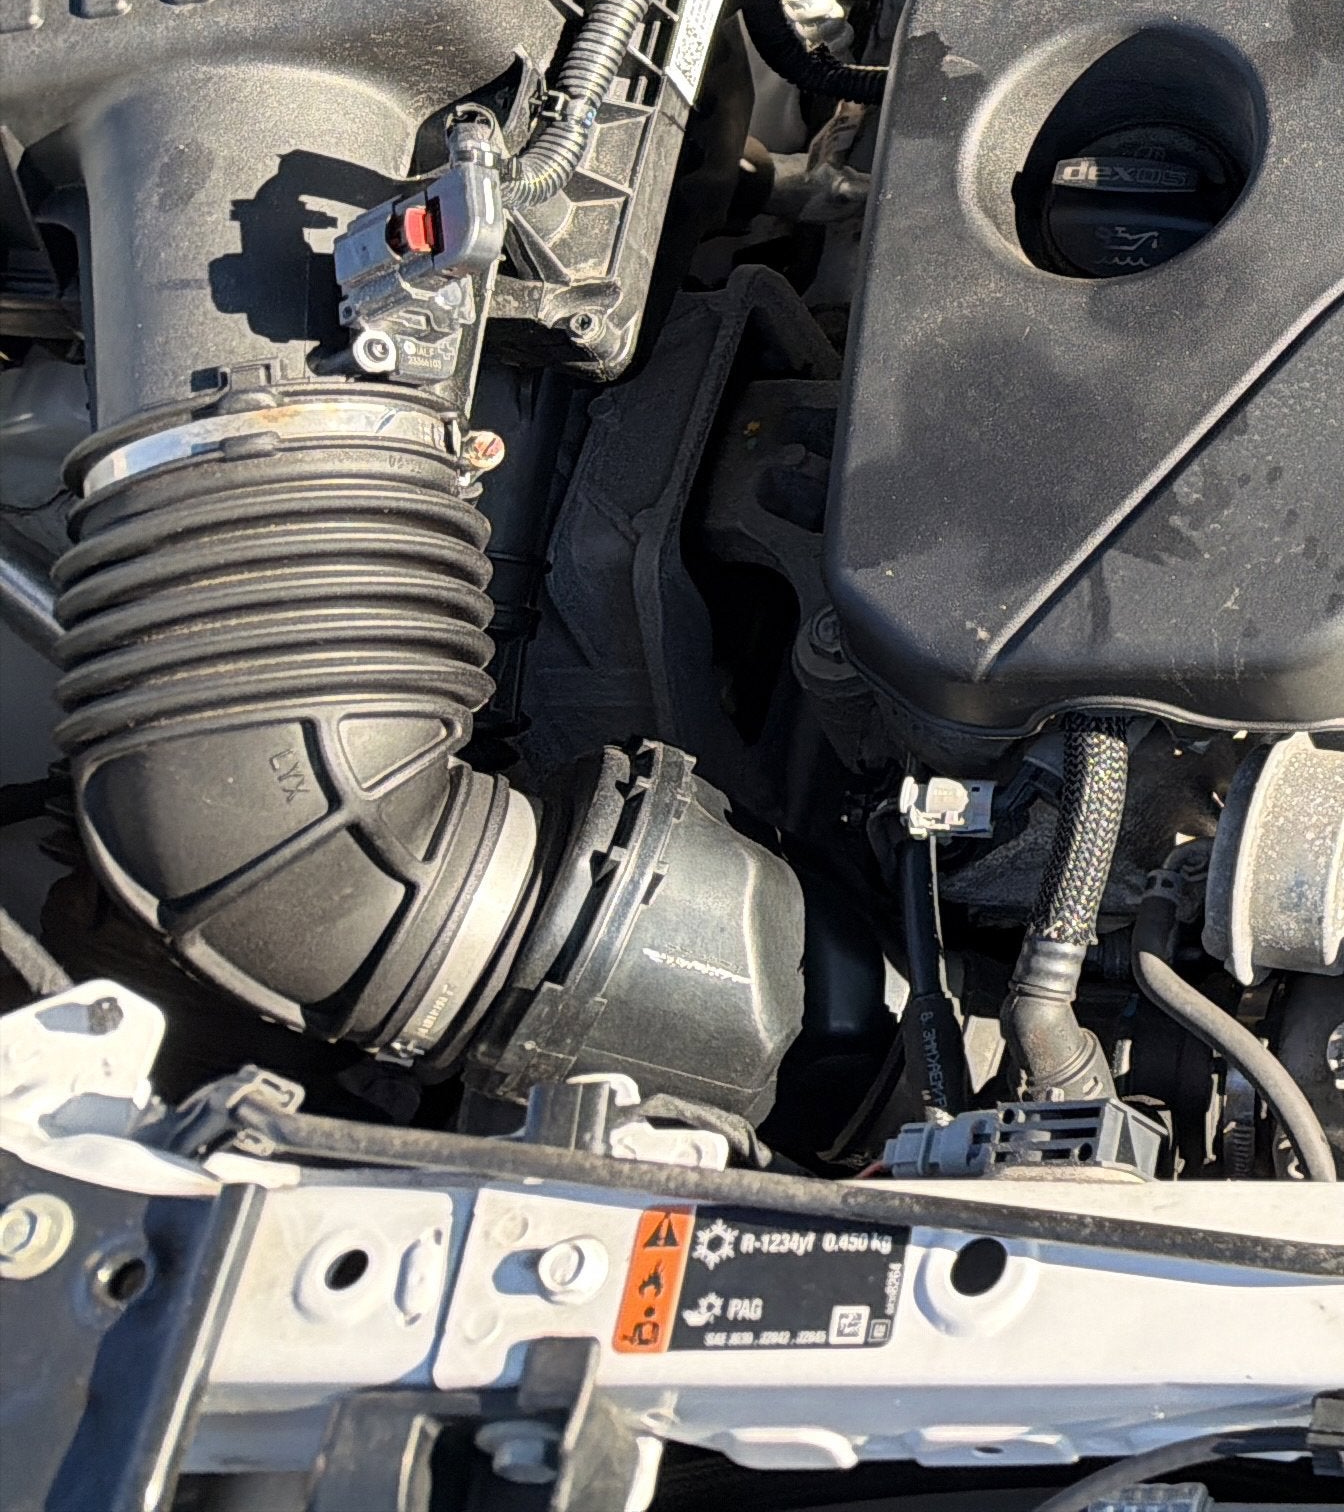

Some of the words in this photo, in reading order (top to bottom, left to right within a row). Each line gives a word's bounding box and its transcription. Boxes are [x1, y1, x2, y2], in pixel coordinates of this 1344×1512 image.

[1063, 161, 1186, 187] dexos
[269, 749, 311, 803] LYX
[739, 1231, 816, 1256] R-1234yf
[822, 1233, 868, 1253] 0.450
[870, 1232, 893, 1255] kg
[727, 1298, 763, 1321] PAG
